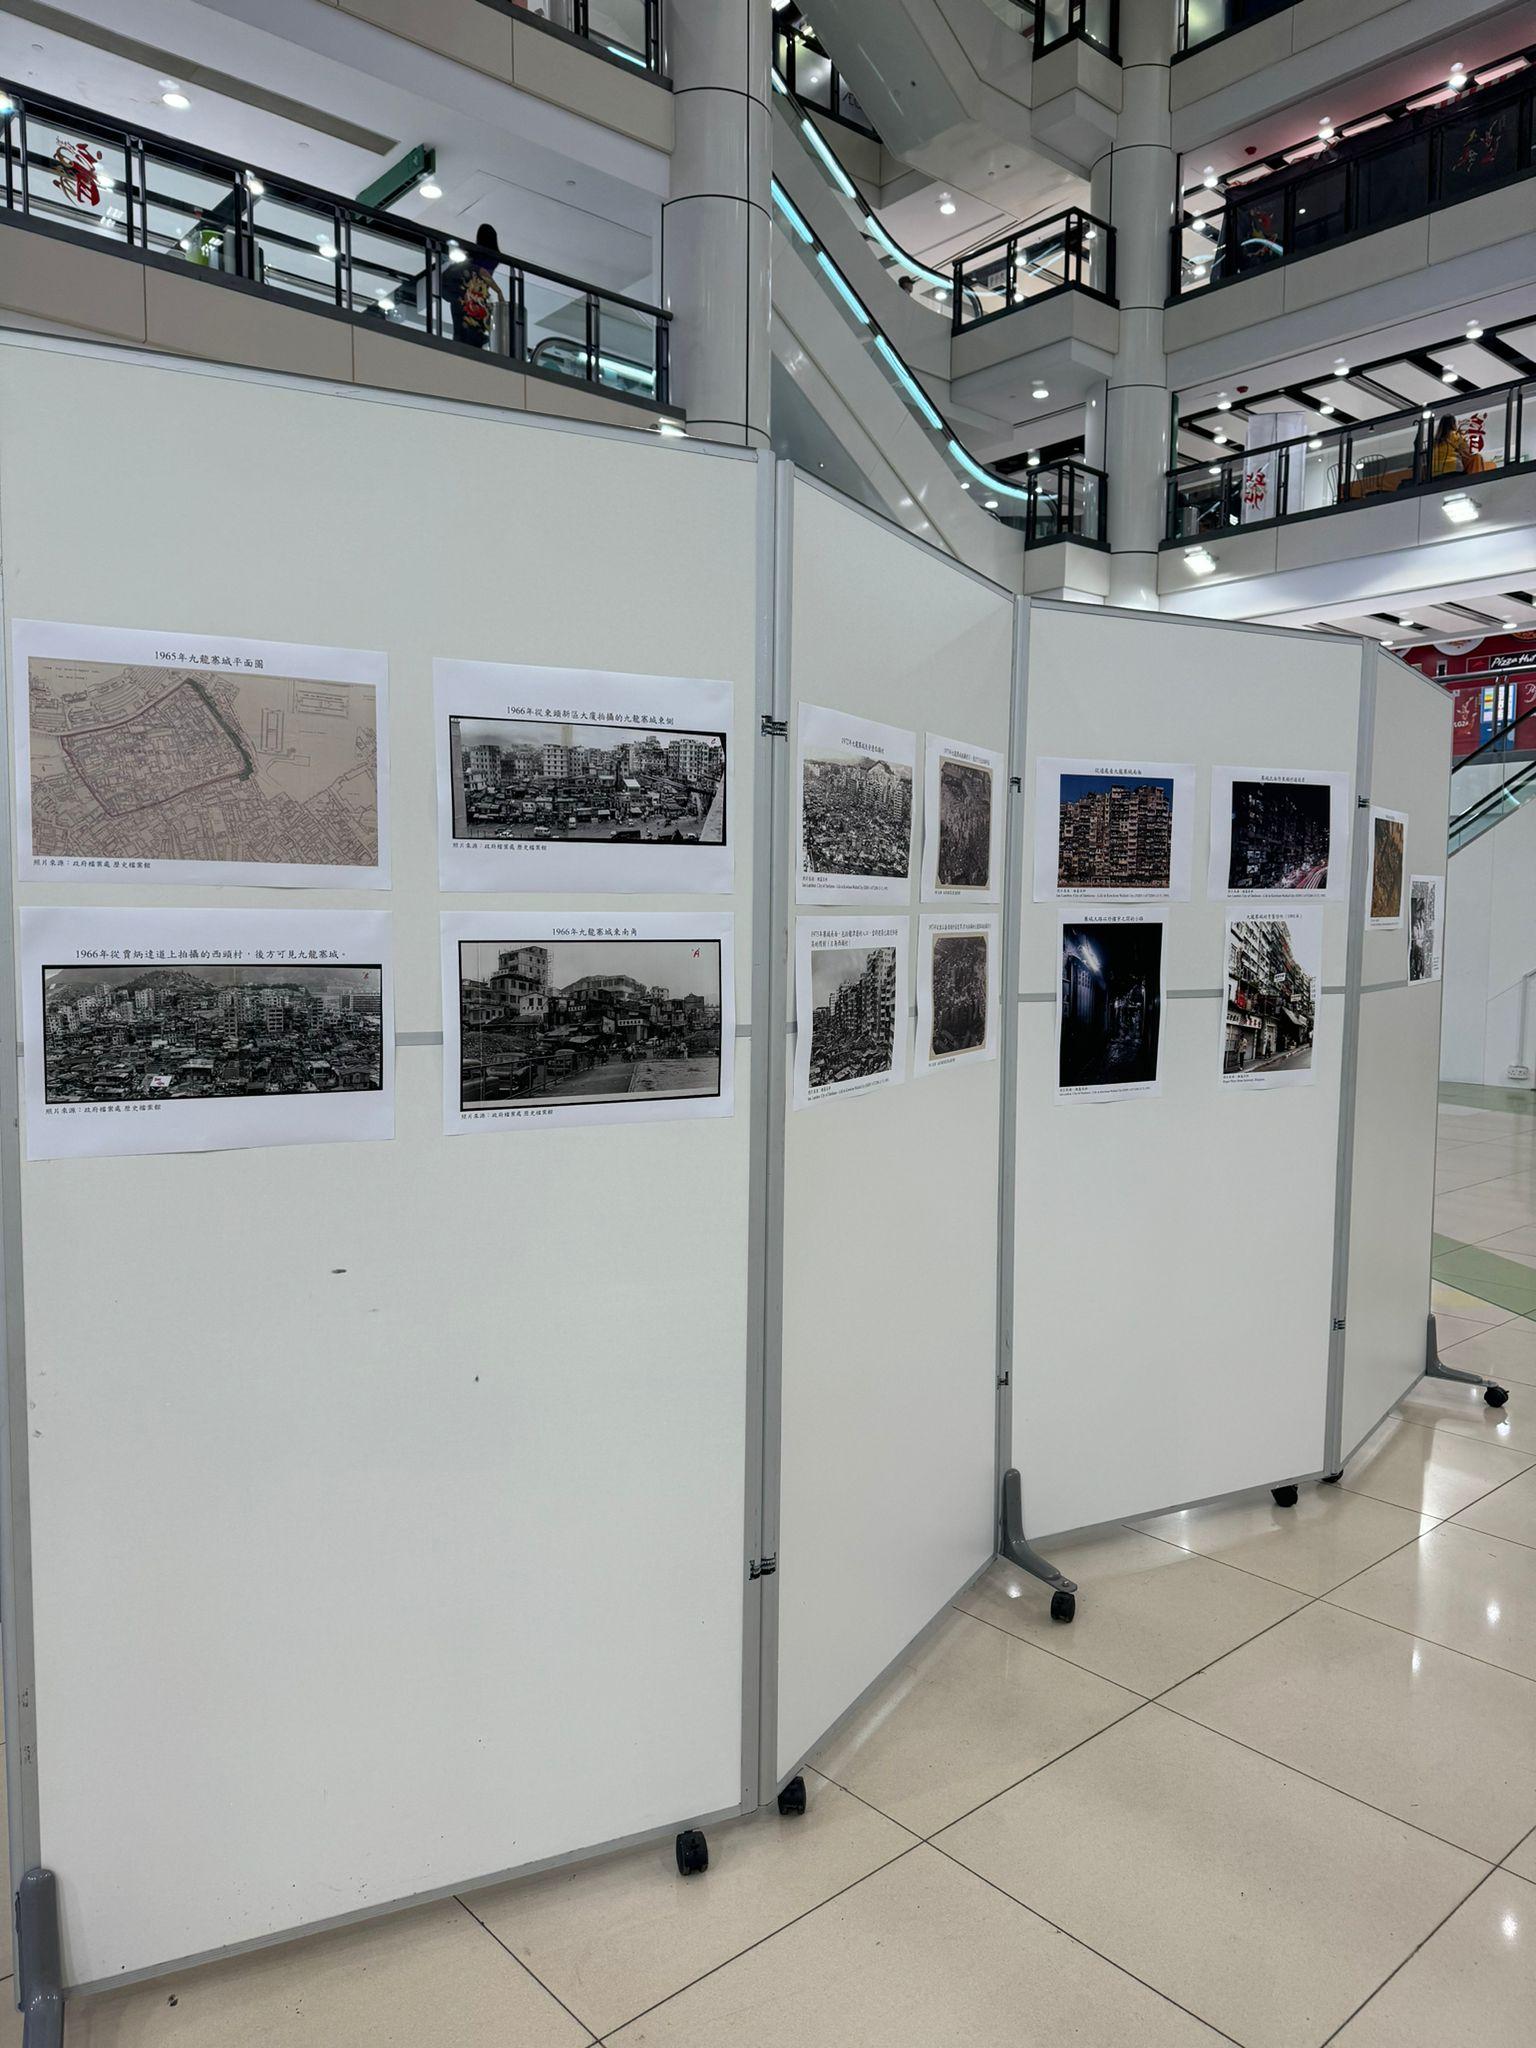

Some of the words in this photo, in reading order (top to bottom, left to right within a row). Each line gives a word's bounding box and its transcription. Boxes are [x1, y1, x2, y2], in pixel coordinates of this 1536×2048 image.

[154, 651, 264, 669] 1965年九龍寨城平面圖
[1491, 656, 1518, 668] Pizza
[552, 927, 638, 937] 1966年九龍寨城東南角
